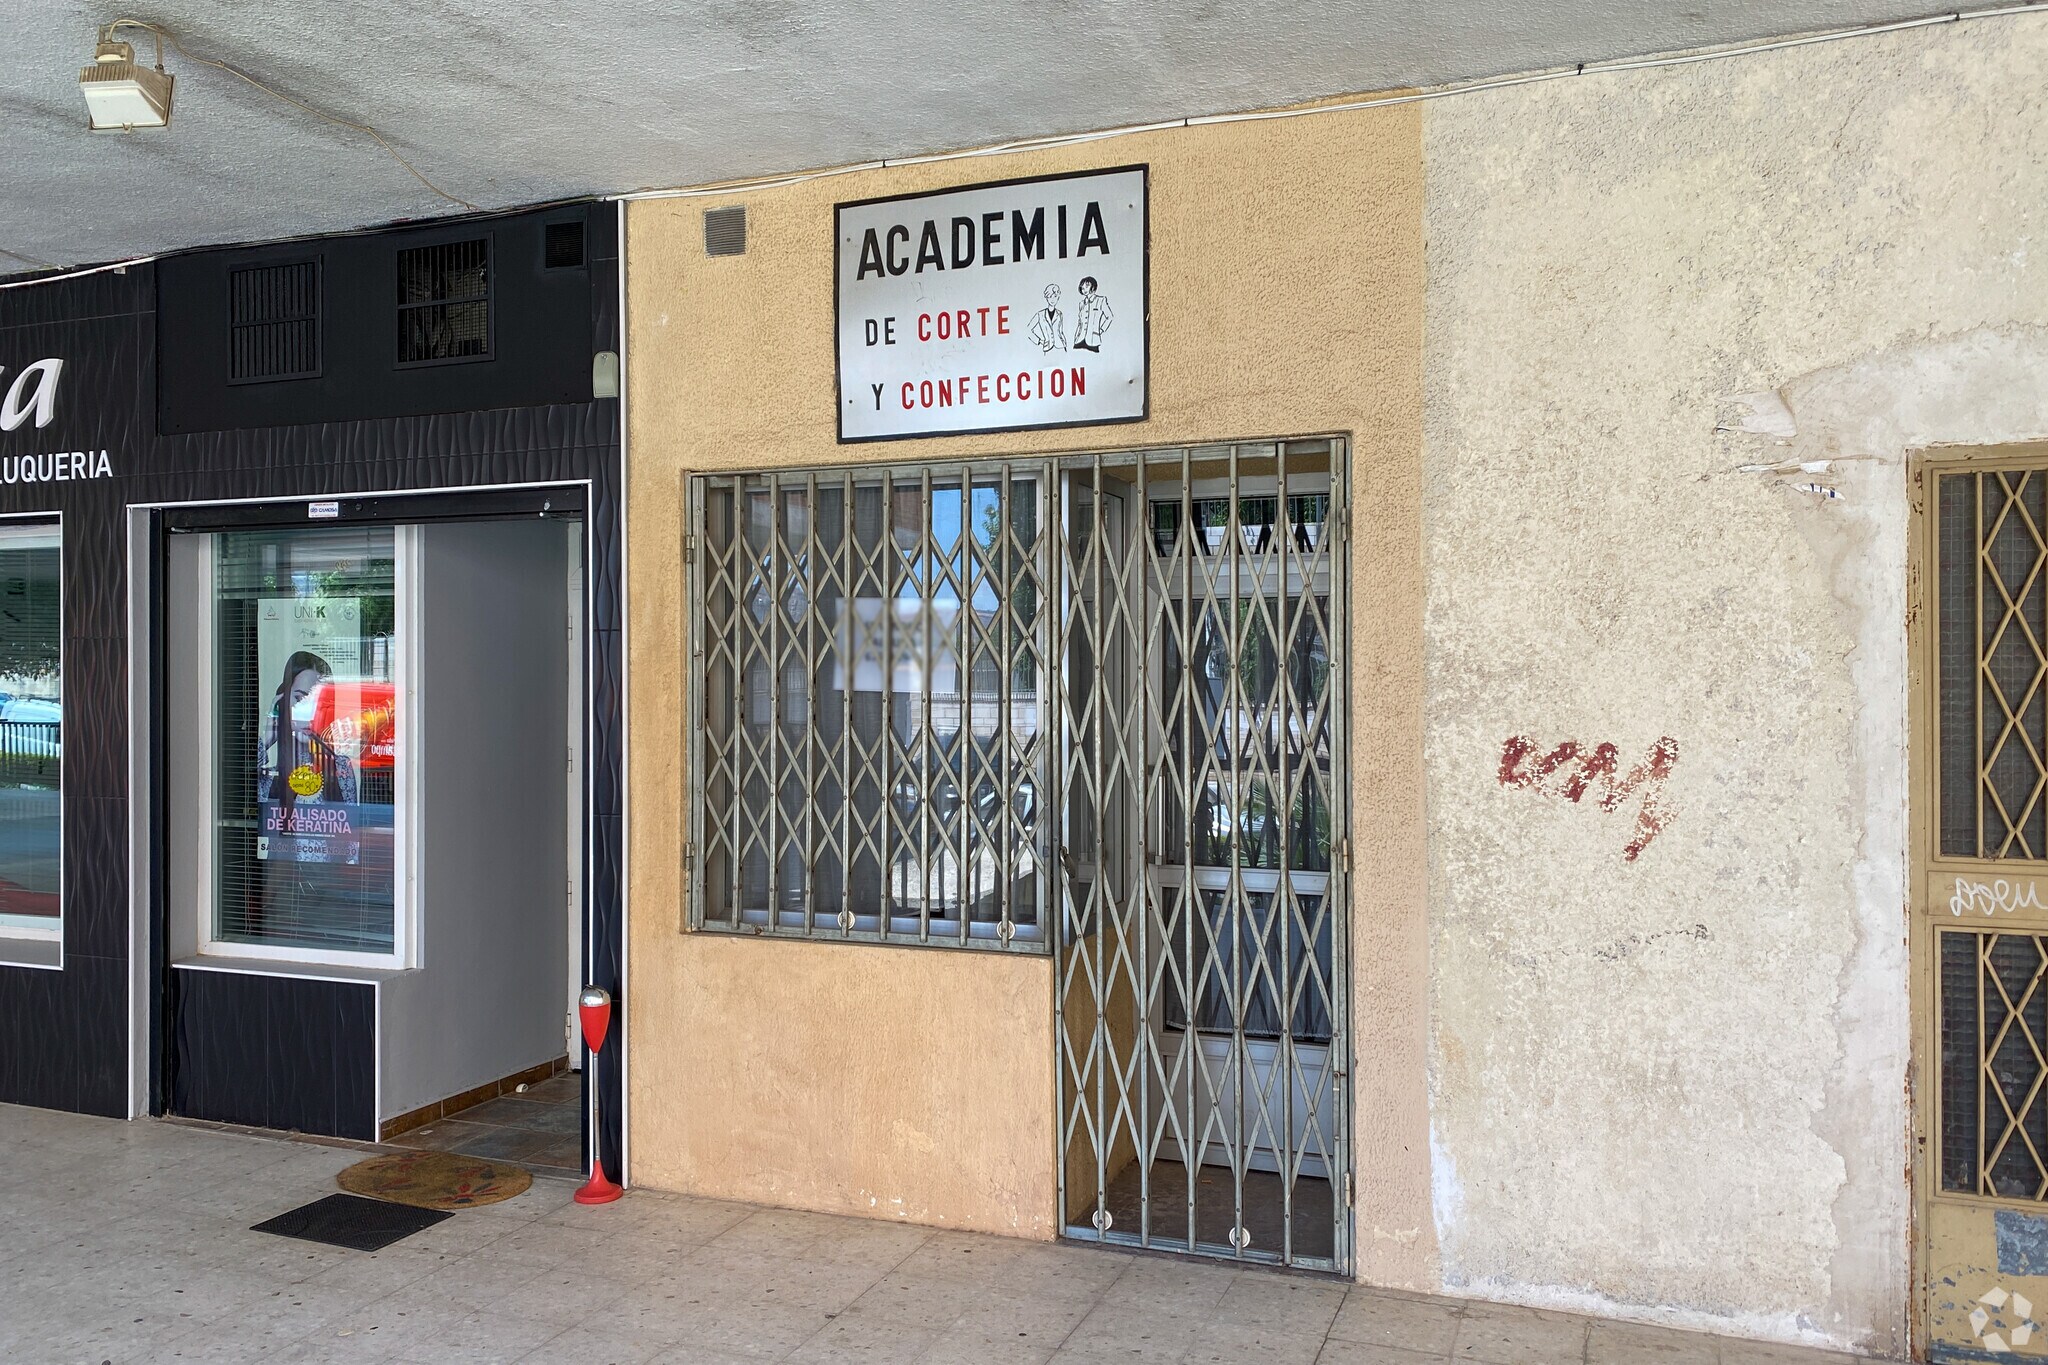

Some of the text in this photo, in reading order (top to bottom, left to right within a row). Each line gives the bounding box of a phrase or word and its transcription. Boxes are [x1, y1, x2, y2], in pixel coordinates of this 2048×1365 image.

[856, 201, 1110, 281] ACADEMIA
[865, 305, 1010, 347] DE CORTE
[0, 358, 63, 431] a
[871, 366, 1086, 411] Y CONFECCION
[267, 818, 352, 834] DE KERATINA
[270, 806, 347, 822] TU ALISADO
